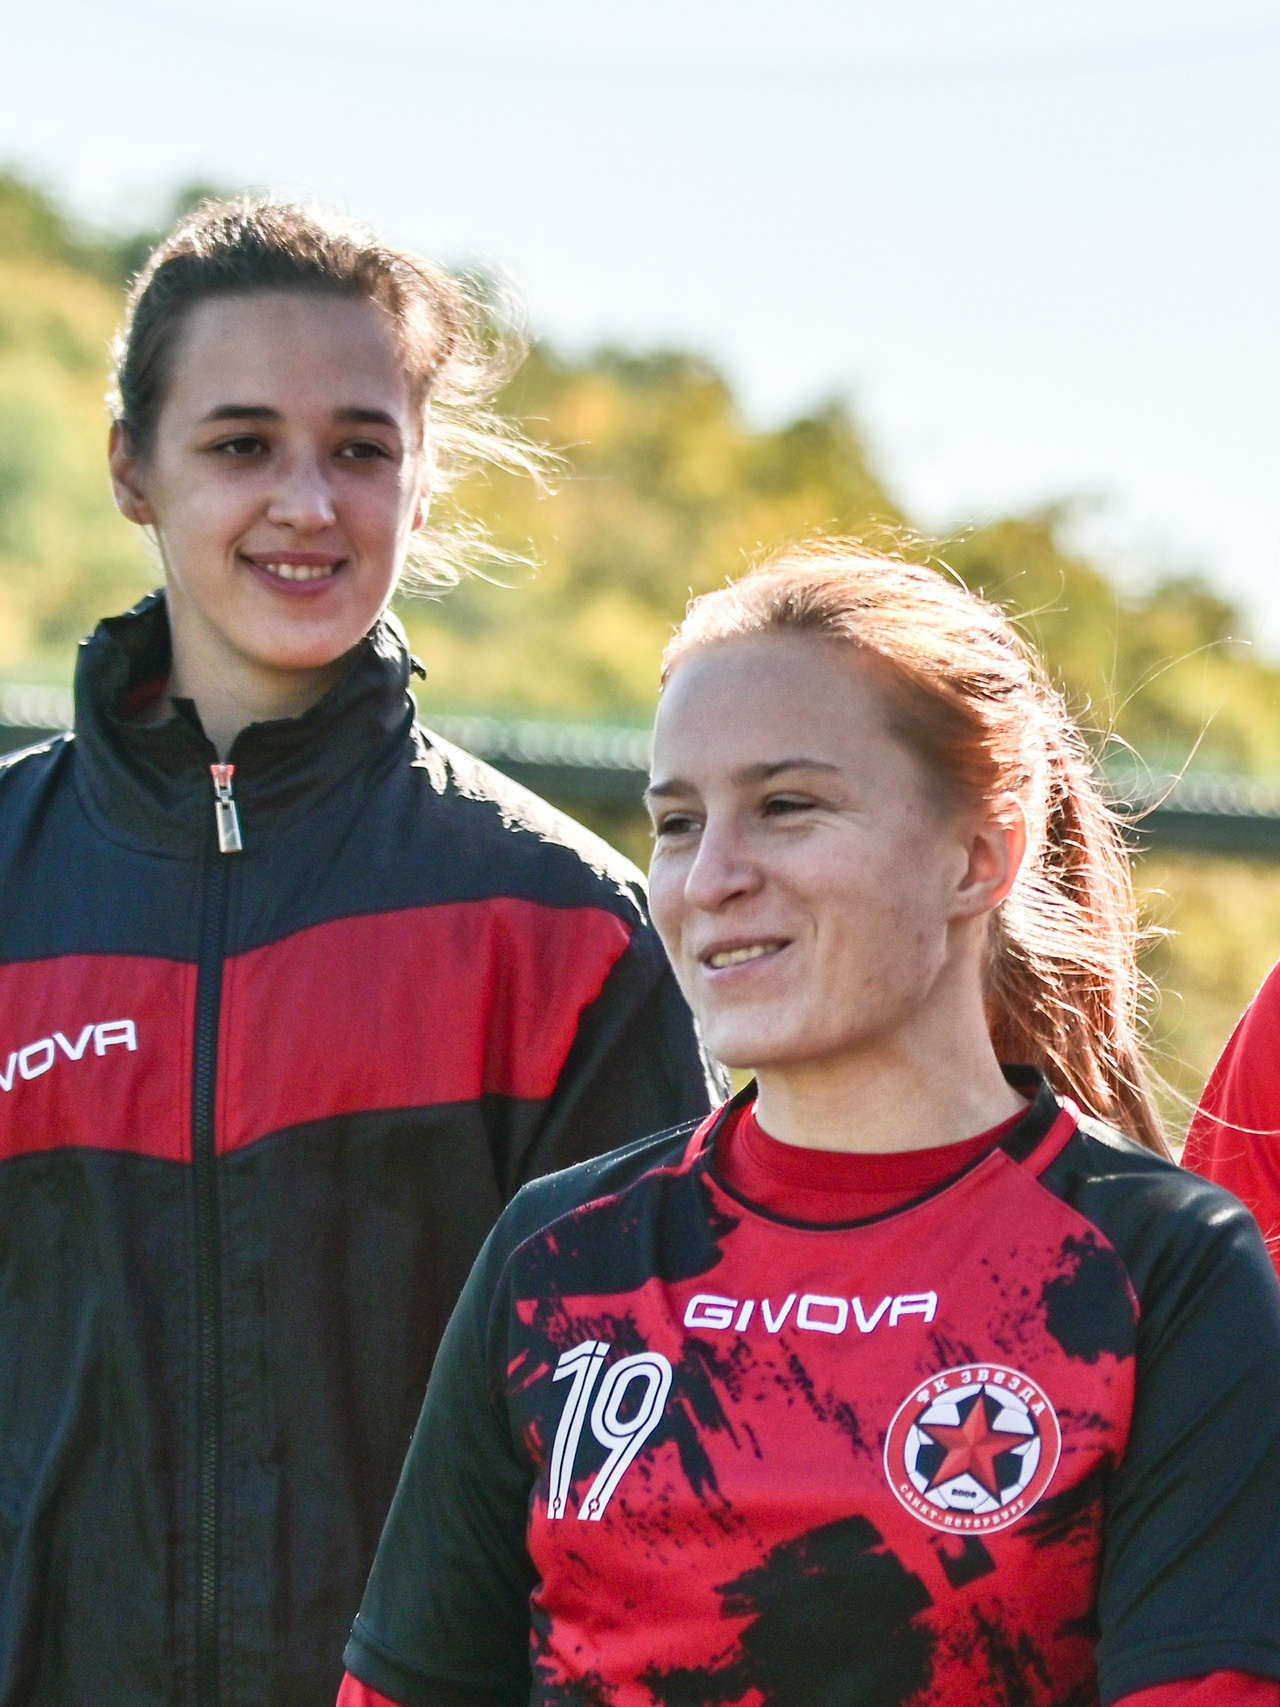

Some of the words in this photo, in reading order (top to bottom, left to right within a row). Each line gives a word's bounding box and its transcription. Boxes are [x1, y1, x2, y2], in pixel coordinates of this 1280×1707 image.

[683, 1290, 938, 1334] GIVOVA
[916, 1378, 949, 1404] ФК
[547, 1340, 673, 1521] 19
